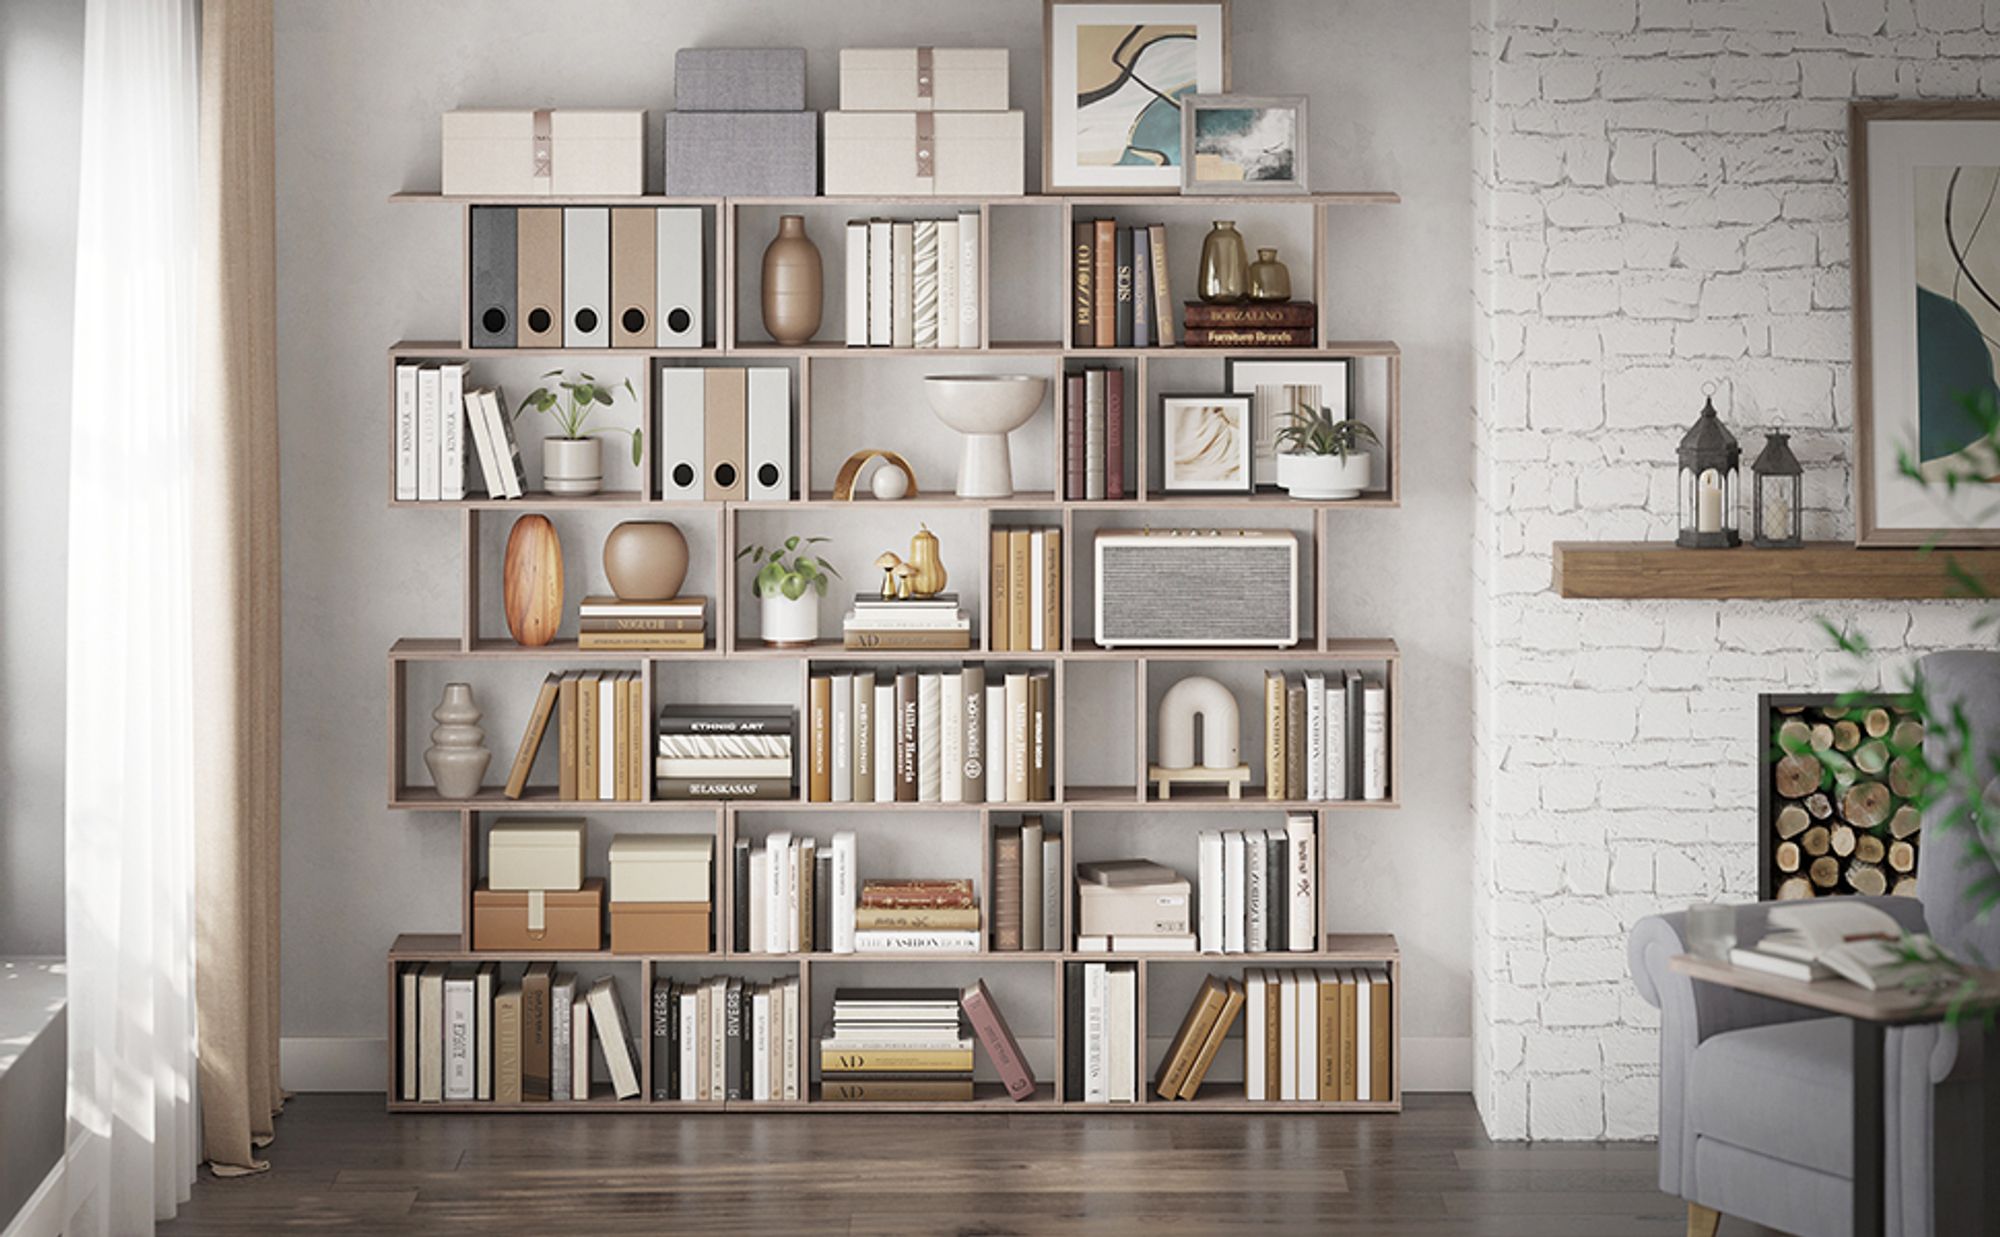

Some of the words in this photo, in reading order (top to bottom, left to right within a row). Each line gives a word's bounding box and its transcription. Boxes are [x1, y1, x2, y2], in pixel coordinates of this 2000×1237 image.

[1208, 331, 1255, 342] Furniture
[857, 633, 880, 647] AD
[690, 722, 736, 731] ETHNIC
[740, 722, 764, 731] ART
[905, 701, 916, 740] Miller
[1015, 702, 1026, 740] Miller
[1273, 705, 1281, 759] FASHION
[905, 742, 915, 783] Harris
[886, 937, 938, 947] FASHION
[654, 992, 667, 1036] RIVERS
[727, 992, 740, 1036] RIVERS
[839, 1056, 865, 1068] AD
[839, 1086, 864, 1098] AD
